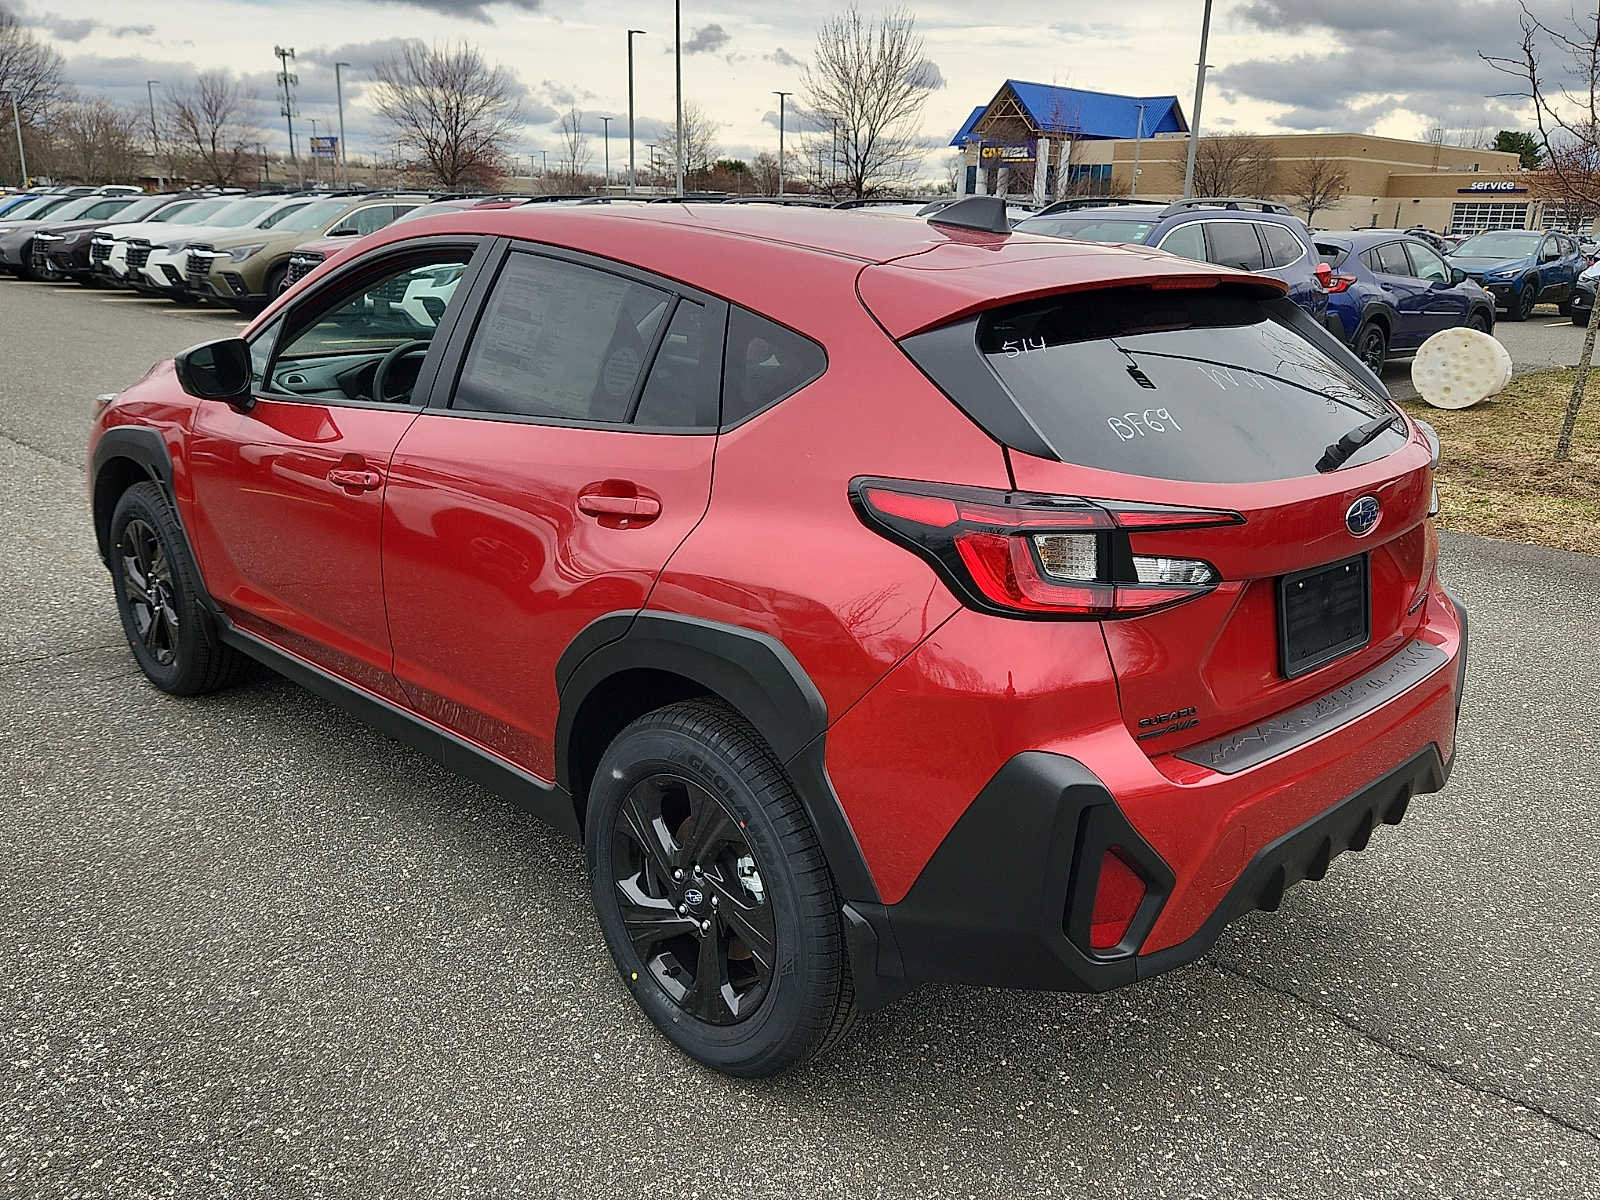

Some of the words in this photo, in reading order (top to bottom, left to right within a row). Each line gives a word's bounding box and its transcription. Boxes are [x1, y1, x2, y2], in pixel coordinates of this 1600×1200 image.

[1471, 180, 1515, 190] service
[1002, 335, 1047, 358] 514
[1107, 407, 1182, 442] BF69
[1138, 705, 1198, 727] SUBARU
